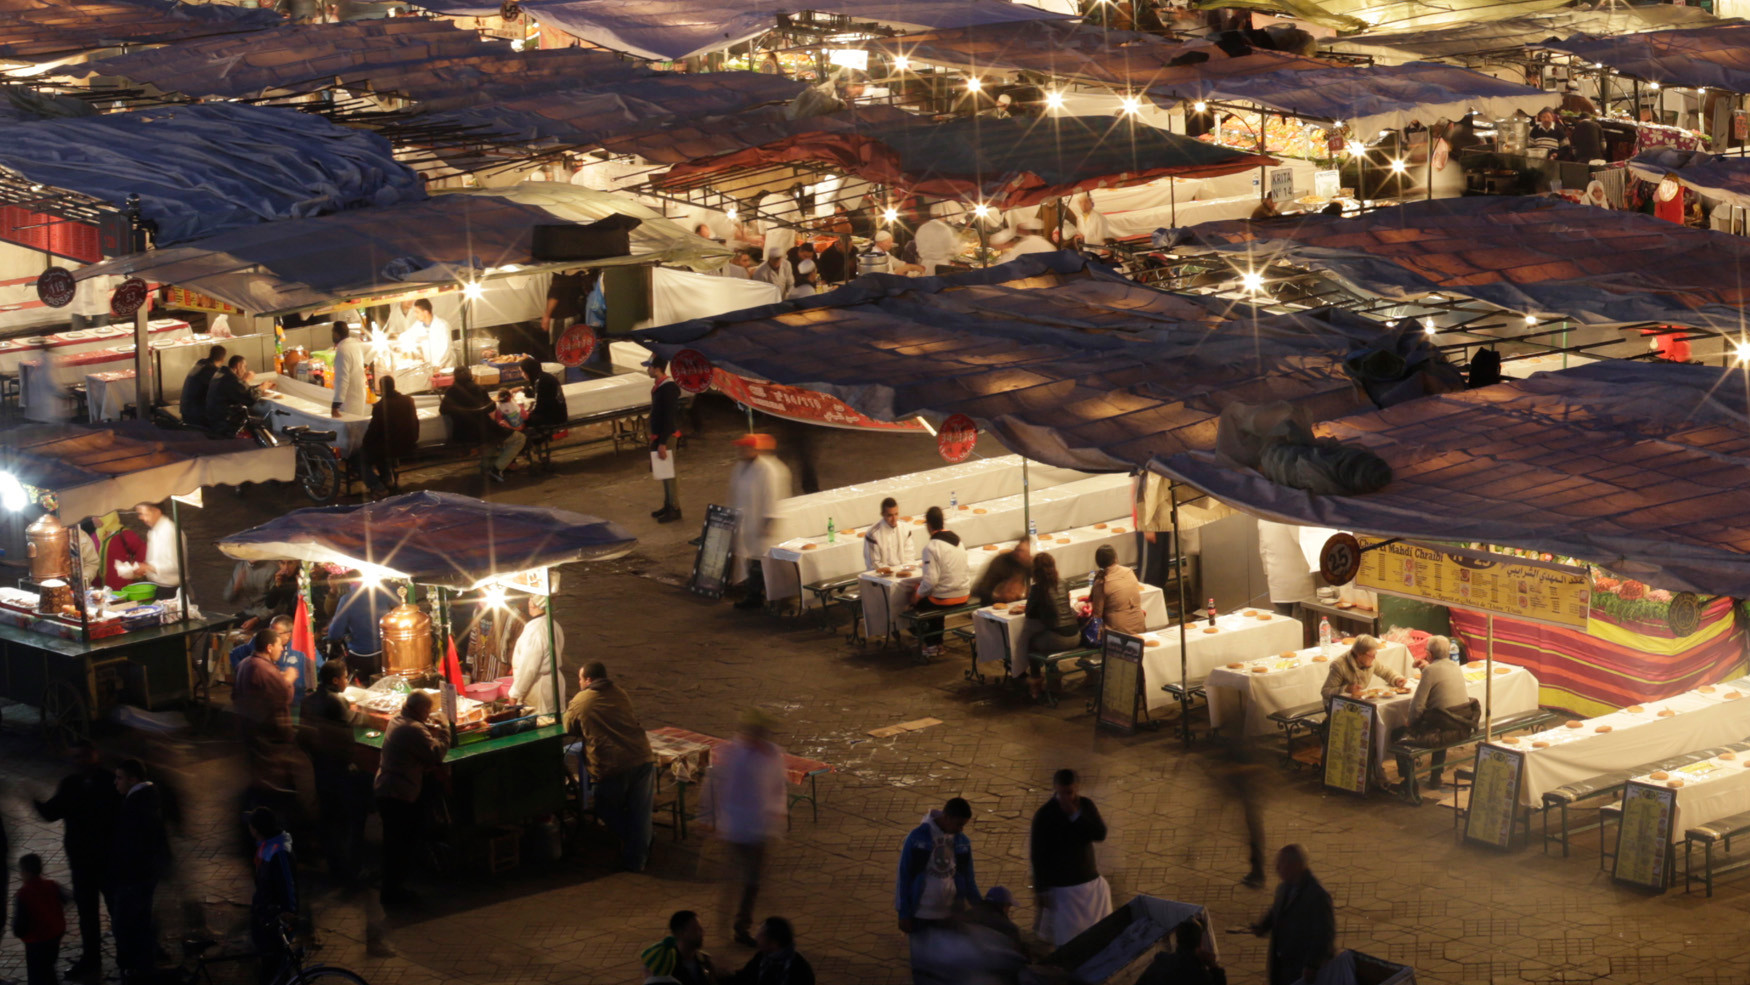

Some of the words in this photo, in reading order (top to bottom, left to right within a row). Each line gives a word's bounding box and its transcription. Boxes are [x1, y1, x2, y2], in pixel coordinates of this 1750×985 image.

[1272, 172, 1291, 184] KRITA
[1285, 187, 1292, 197] 14
[1329, 548, 1348, 572] 25
[1389, 543, 1413, 557] Mahdi
[1414, 548, 1444, 563] Chraibi
